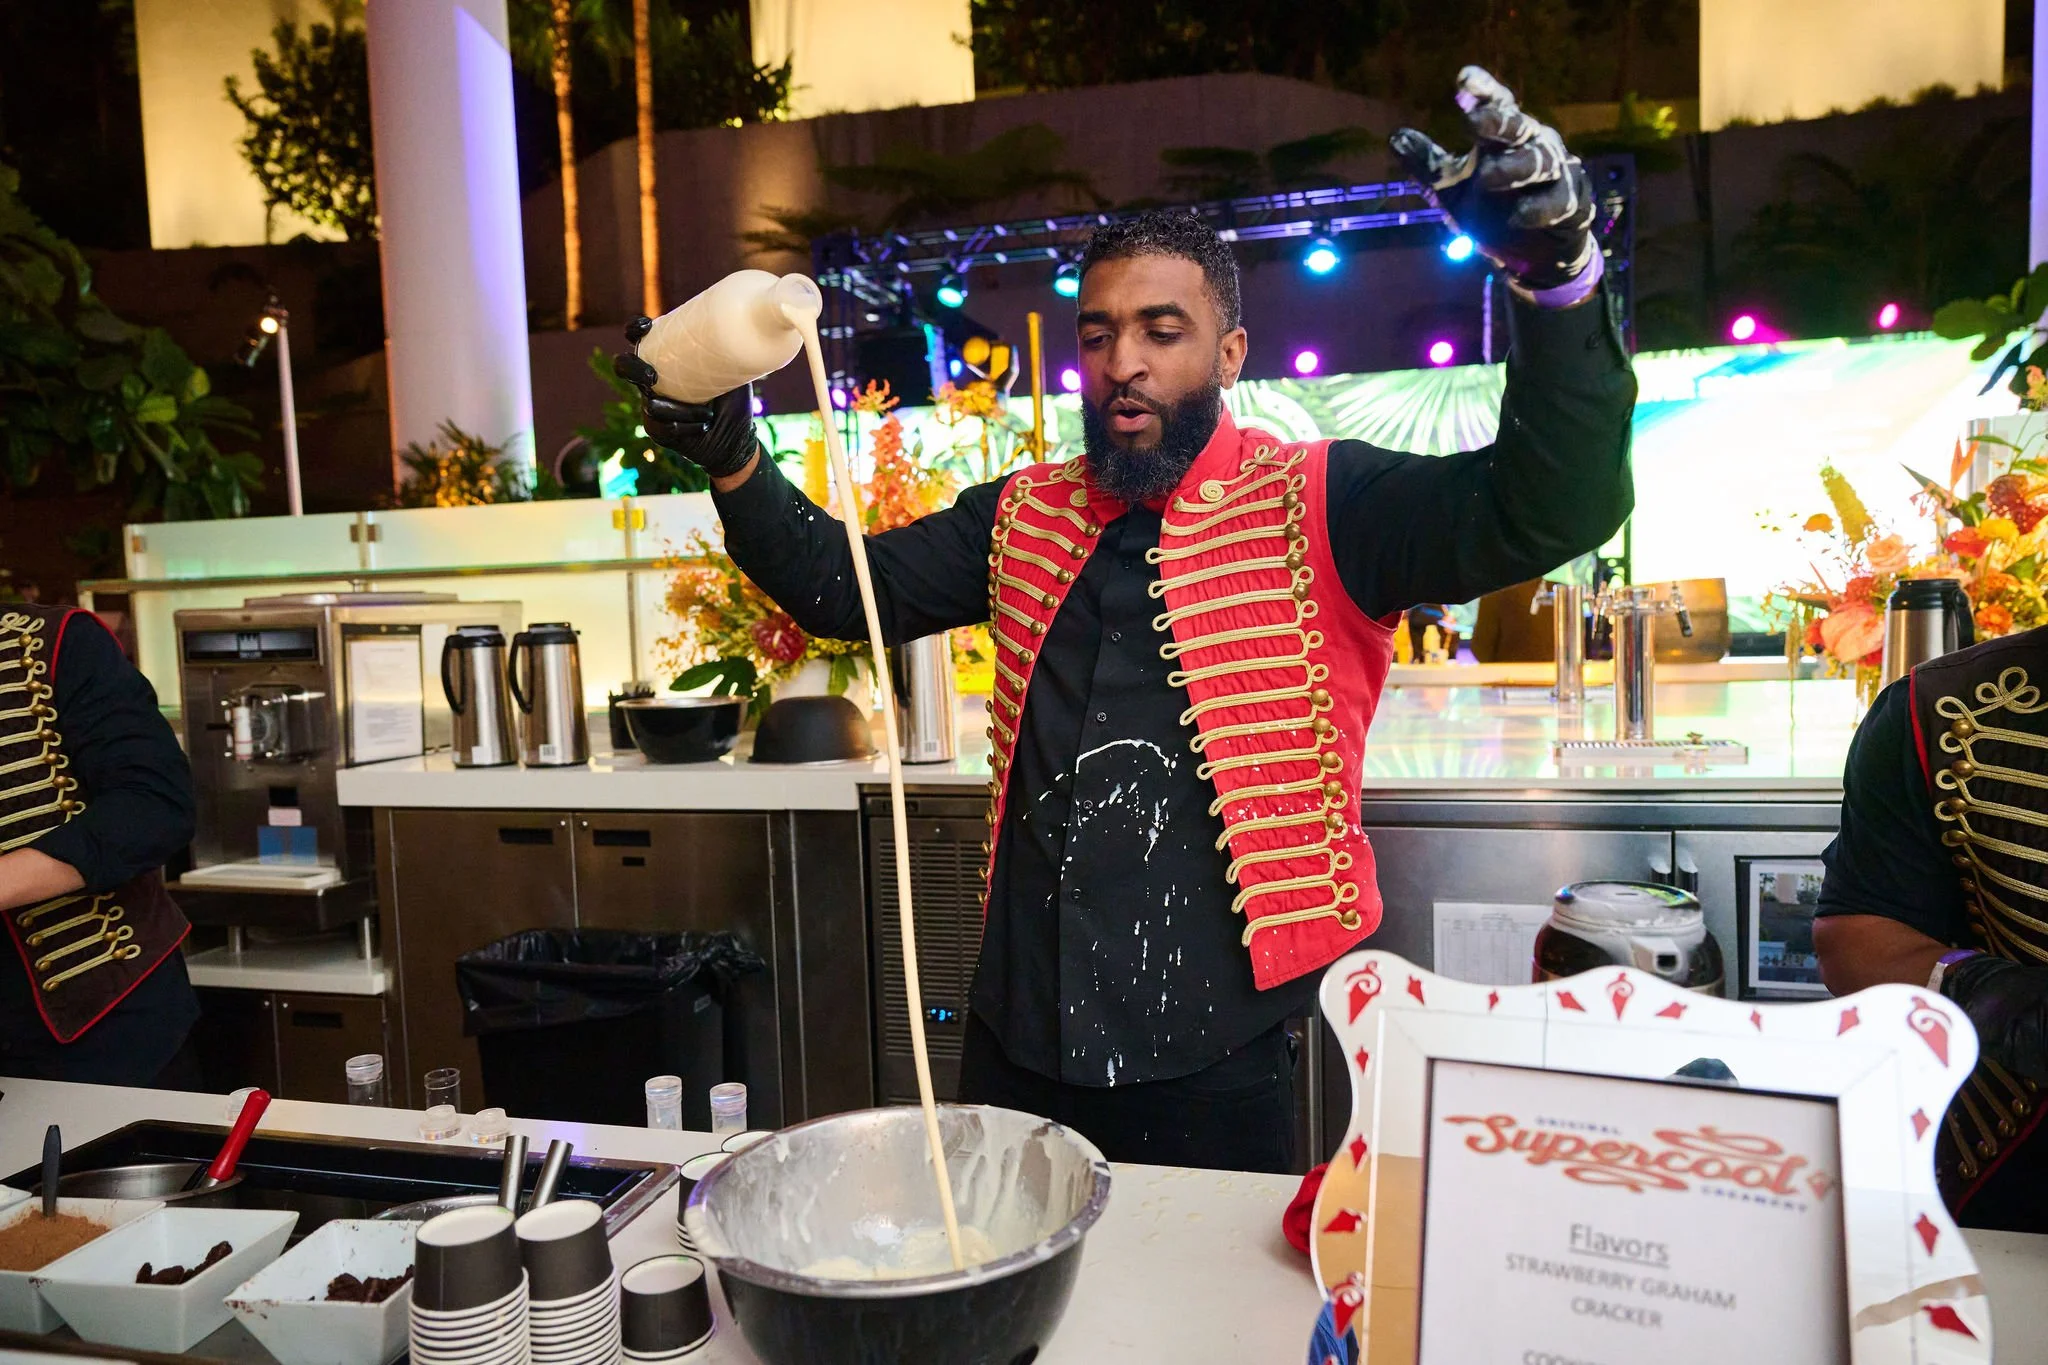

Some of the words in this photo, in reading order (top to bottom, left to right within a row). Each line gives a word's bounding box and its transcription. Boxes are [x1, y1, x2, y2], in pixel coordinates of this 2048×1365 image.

[1443, 1114, 1808, 1193] Supercool
[1569, 1222, 1670, 1263] Flavors
[1505, 1252, 1637, 1292] STRAWBERRY
[1640, 1277, 1737, 1311] GRAHAM
[1570, 1296, 1663, 1329] CRACKER
